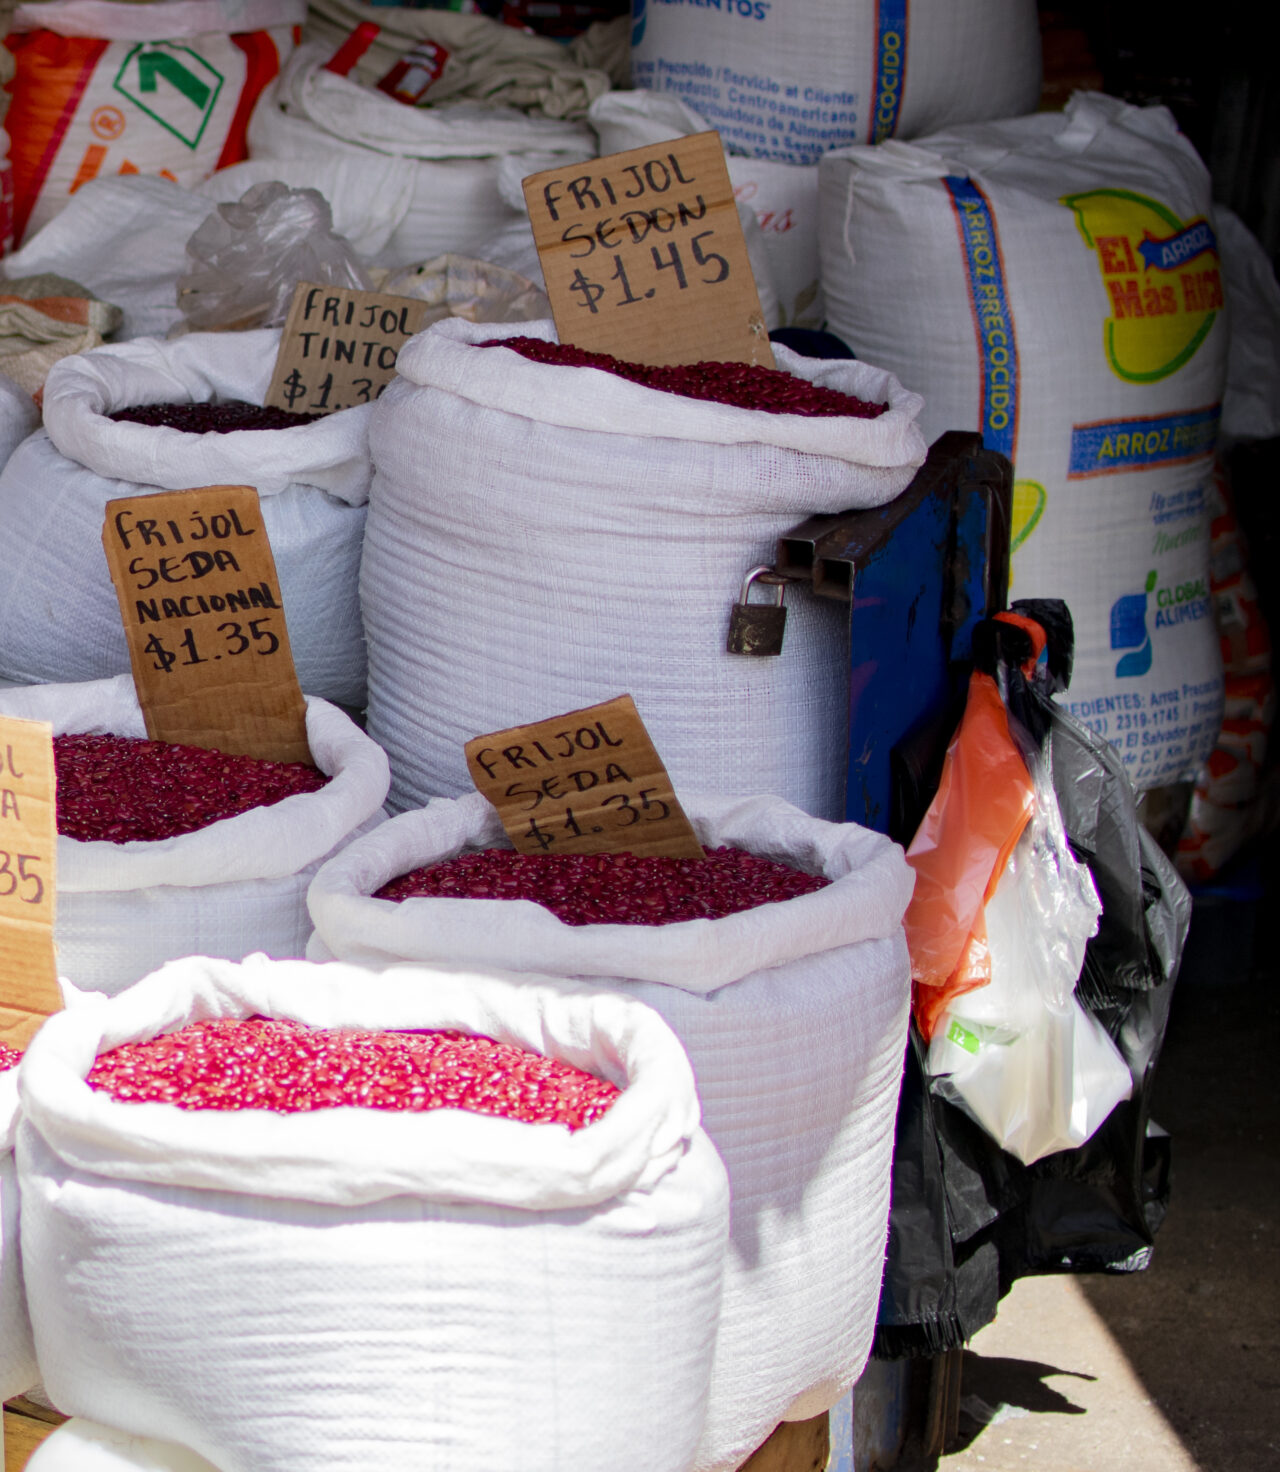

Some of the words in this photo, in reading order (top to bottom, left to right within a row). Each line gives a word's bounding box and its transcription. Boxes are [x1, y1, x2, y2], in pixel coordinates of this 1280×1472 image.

[723, 67, 780, 94] Servicio
[785, 86, 799, 99] al
[727, 87, 857, 124] Centroamericano
[768, 113, 784, 131] de
[789, 119, 856, 140] Alimentos
[544, 153, 696, 221] FRIJOL
[561, 194, 707, 258] SEDON
[1160, 228, 1210, 267] ARROZ
[569, 230, 730, 314] $1.45
[1095, 235, 1138, 275] El
[303, 288, 414, 336] FRIJOL
[961, 199, 995, 278] ARROZ
[979, 284, 1010, 430] PRECOCIDO
[1107, 277, 1178, 320] Más
[298, 332, 398, 370] TINTO
[283, 368, 388, 410] $1.3
[1097, 428, 1170, 460] ARROZ
[115, 507, 256, 550] FRIJOL
[128, 549, 242, 590] SEDA
[135, 582, 282, 625] NACIONAL
[1156, 578, 1207, 608] GLOBAL
[143, 617, 280, 673] $1.35
[475, 721, 624, 779] FRIJOL
[1126, 732, 1139, 748] El
[504, 762, 633, 812] SEDA
[524, 787, 670, 851] $1.35
